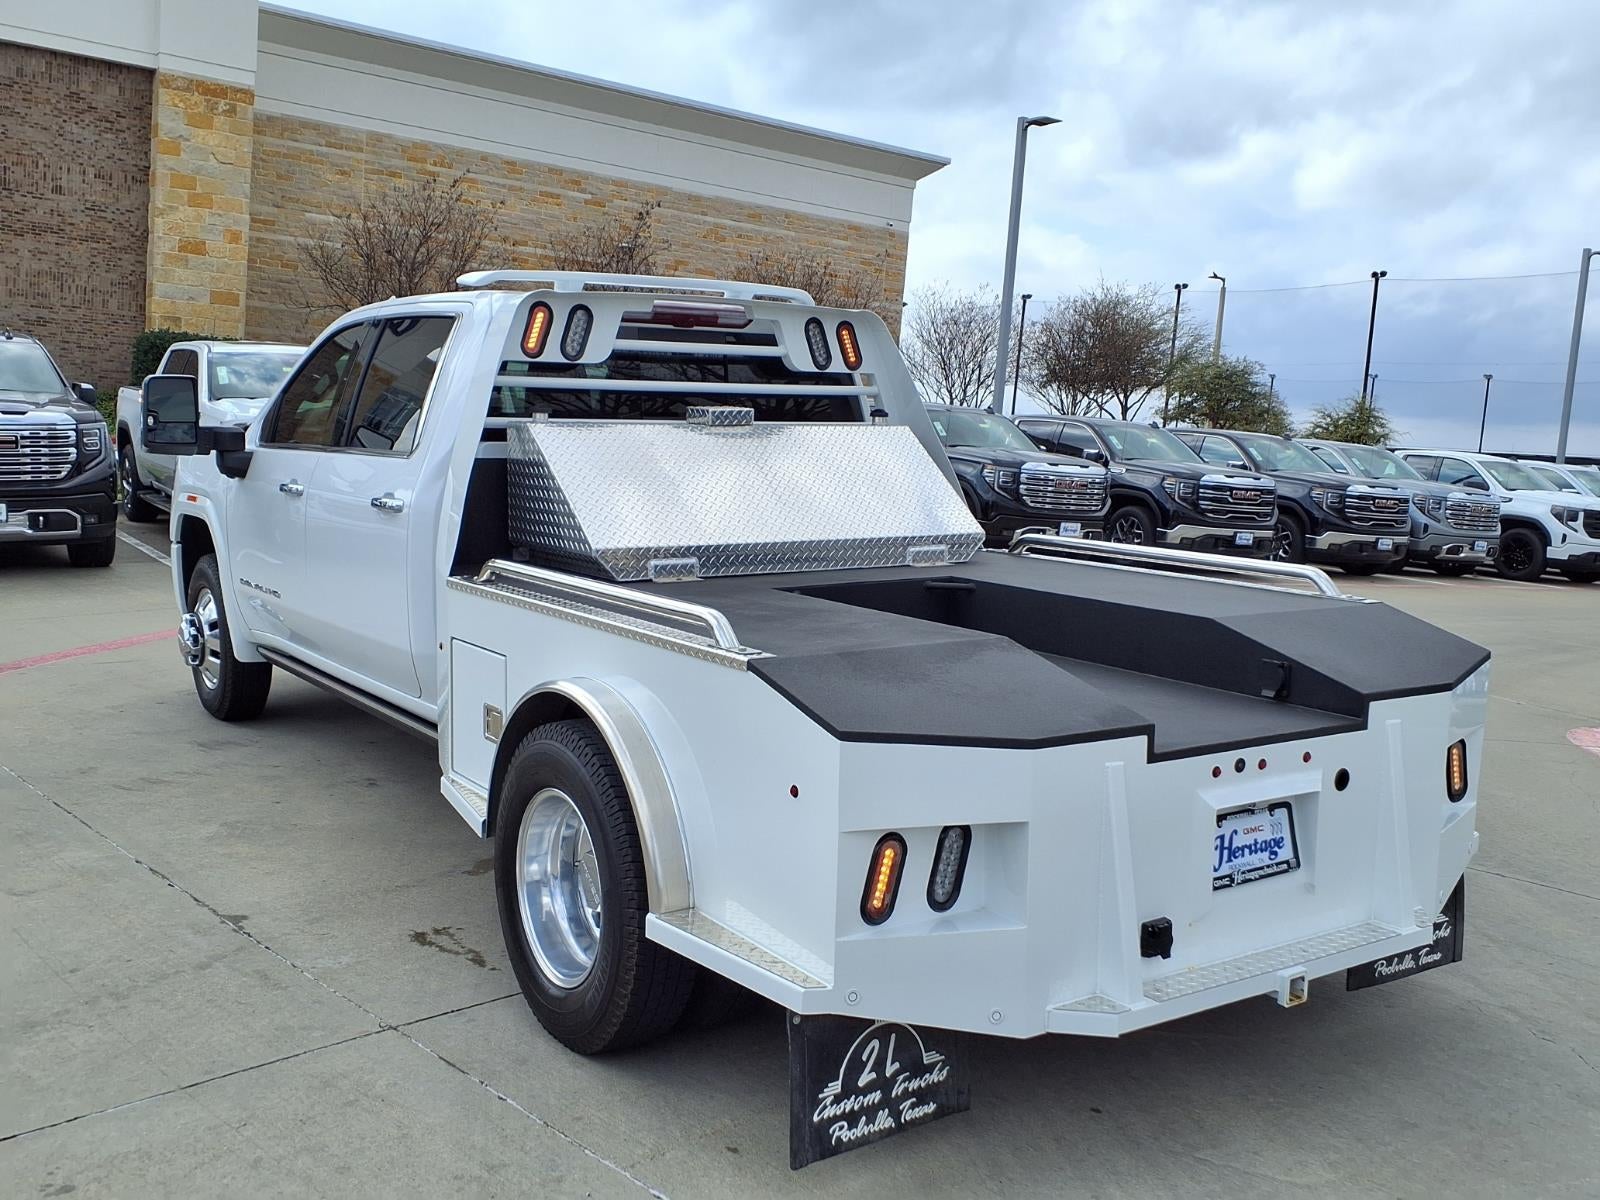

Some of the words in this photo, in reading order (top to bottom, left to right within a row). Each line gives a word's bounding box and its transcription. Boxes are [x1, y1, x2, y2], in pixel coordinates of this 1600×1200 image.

[1243, 825, 1264, 835] GMC
[1213, 829, 1285, 873] Heritage
[813, 1090, 882, 1122] Custom
[891, 1061, 951, 1098] Trucks
[899, 1098, 938, 1124] Texas
